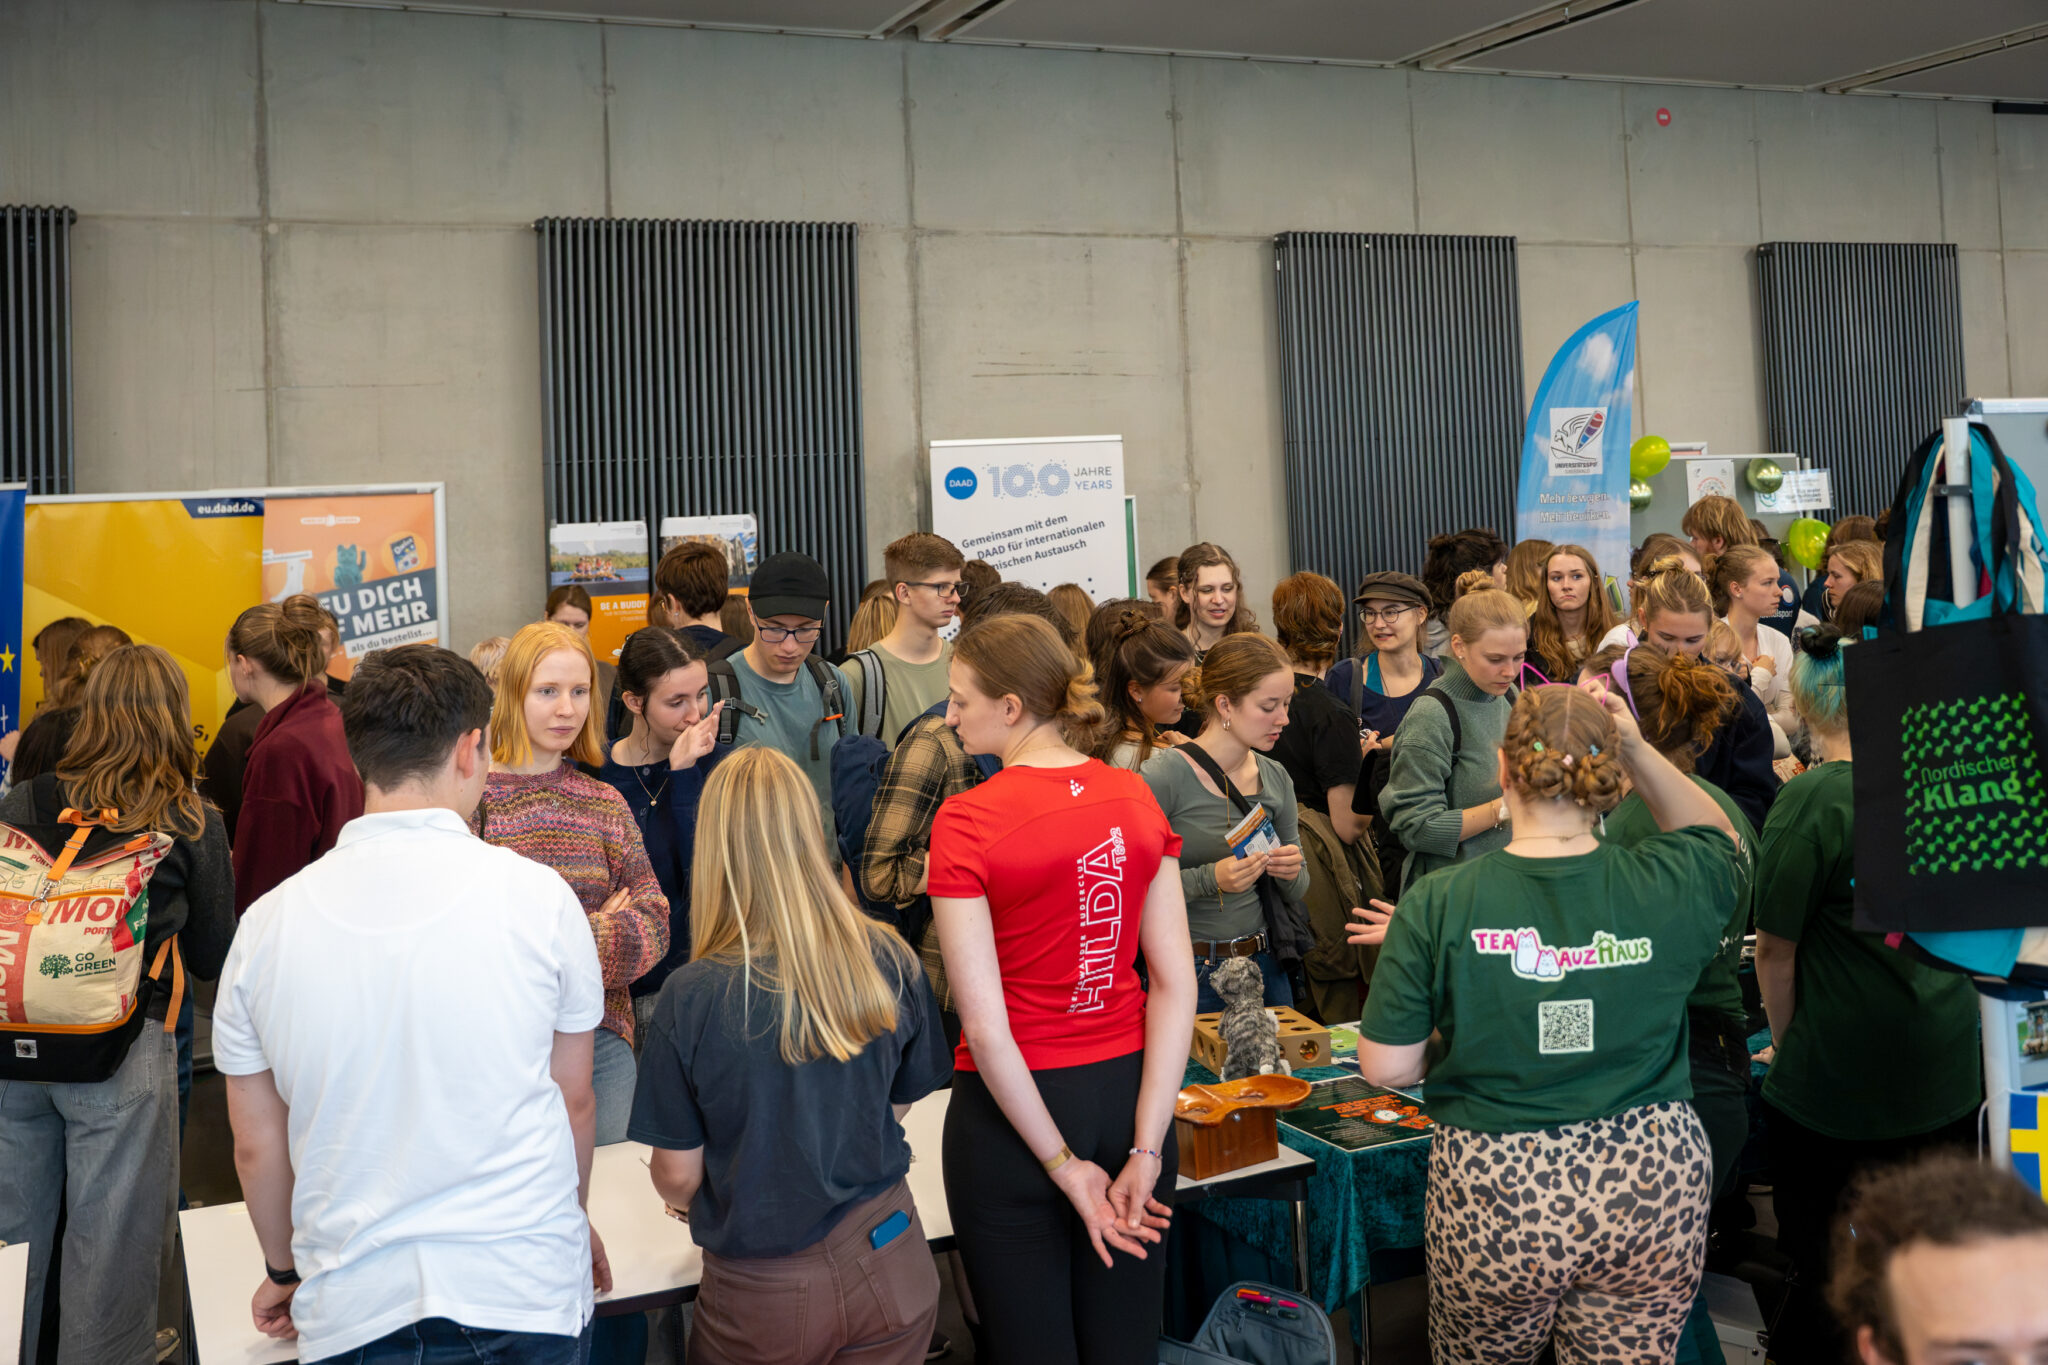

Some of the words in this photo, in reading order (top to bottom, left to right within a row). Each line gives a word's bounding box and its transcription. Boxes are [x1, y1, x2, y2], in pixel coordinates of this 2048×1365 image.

[949, 479, 973, 488] DAAD
[986, 463, 1071, 498] 100
[1074, 466, 1112, 477] JAHRE
[1075, 480, 1113, 490] YEARS
[198, 502, 255, 514] eu.daad.de
[1540, 493, 1565, 504] Mehr
[961, 527, 1023, 549] Gemeinsam
[1025, 520, 1042, 533] mit
[1045, 514, 1068, 527] dem
[977, 545, 1005, 560] DAAD
[1007, 541, 1022, 552] für
[1025, 520, 1105, 548] internationalen
[1034, 539, 1087, 560] Austausch
[357, 577, 423, 610] DICH
[600, 602, 610, 611] BE
[612, 602, 618, 610] A
[620, 600, 647, 609] BUDDY
[352, 600, 431, 636] MEHR
[351, 643, 365, 654] als
[367, 640, 380, 650] du
[1110, 827, 1127, 864] 1892
[1076, 857, 1087, 927] RUDERCLUB
[1075, 837, 1123, 1012] HILDA
[75, 952, 95, 962] GO
[75, 957, 116, 972] GREEN
